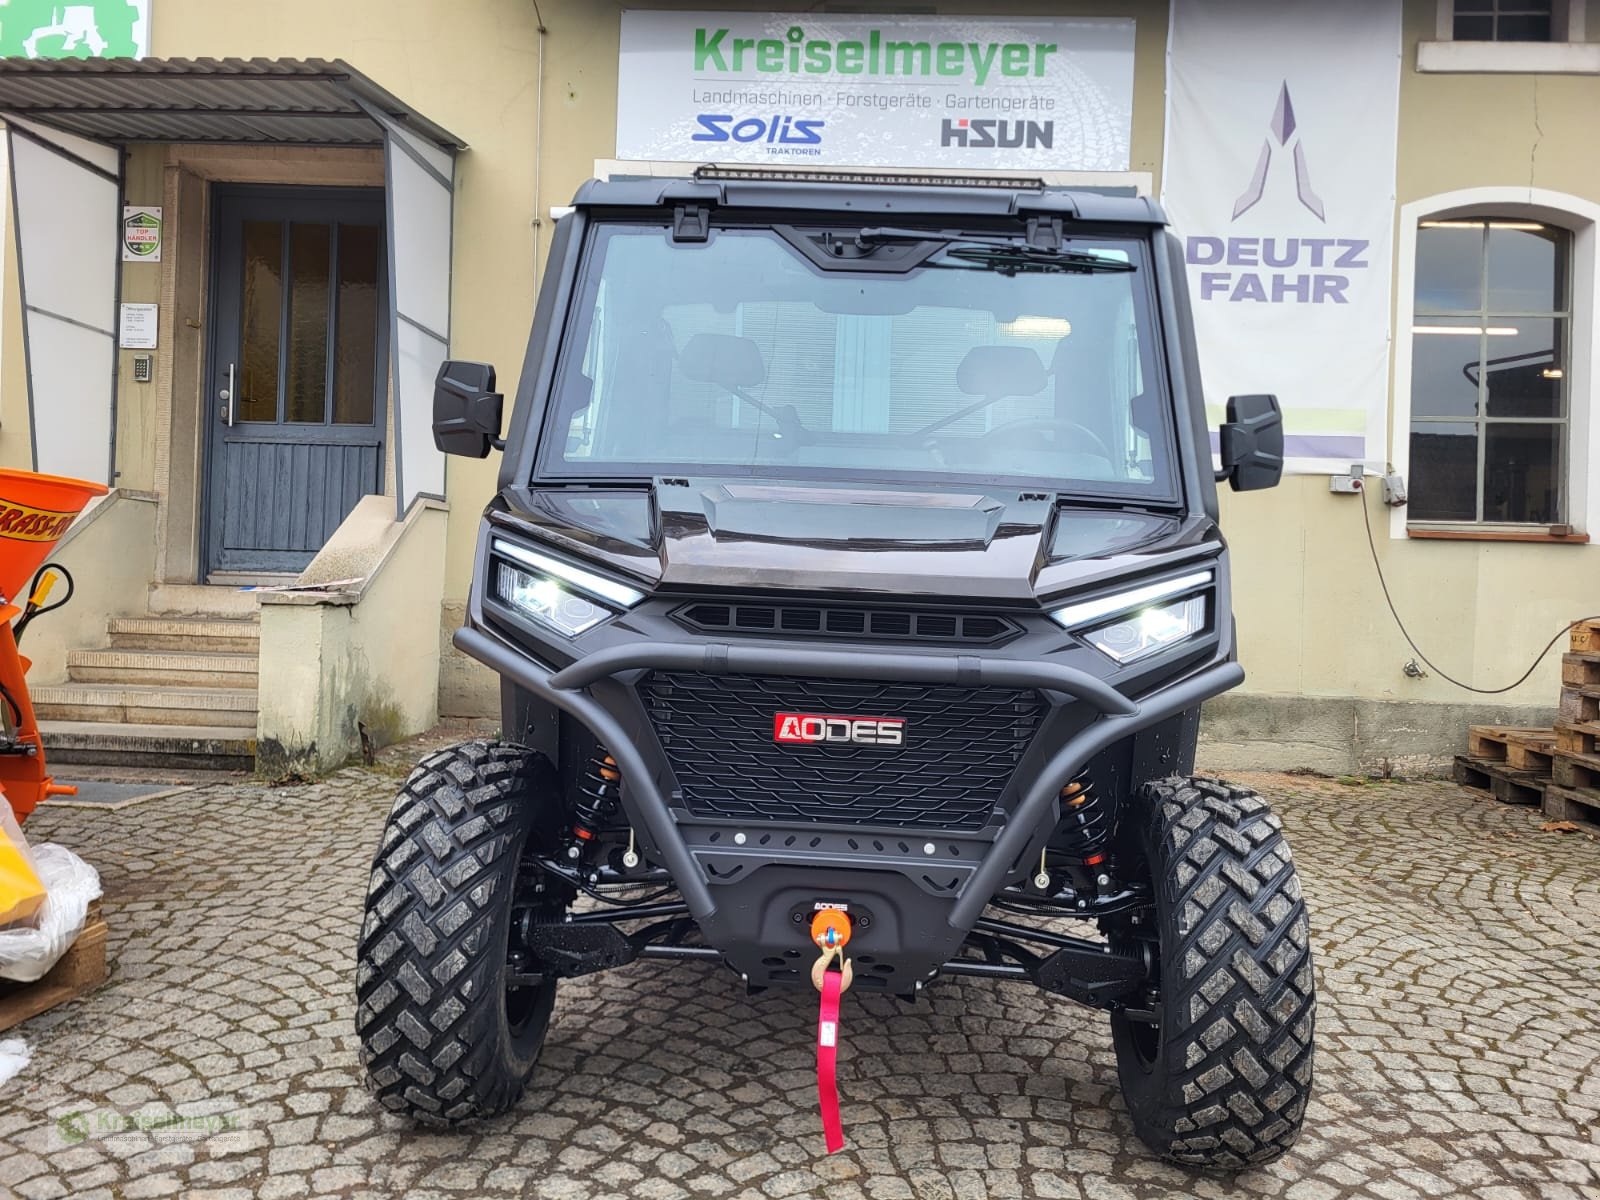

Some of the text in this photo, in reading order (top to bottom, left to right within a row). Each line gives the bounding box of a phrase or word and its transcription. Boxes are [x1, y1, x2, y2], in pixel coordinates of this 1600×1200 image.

[694, 26, 1057, 86] Kreiselmeyer
[693, 88, 1055, 112] Landmaschinen Forstgeräte Gartengeräte
[766, 147, 821, 156] TRAKTOREN
[1186, 236, 1370, 268] DEUTZ
[1200, 272, 1350, 304] FAHR
[779, 716, 902, 744] AODES
